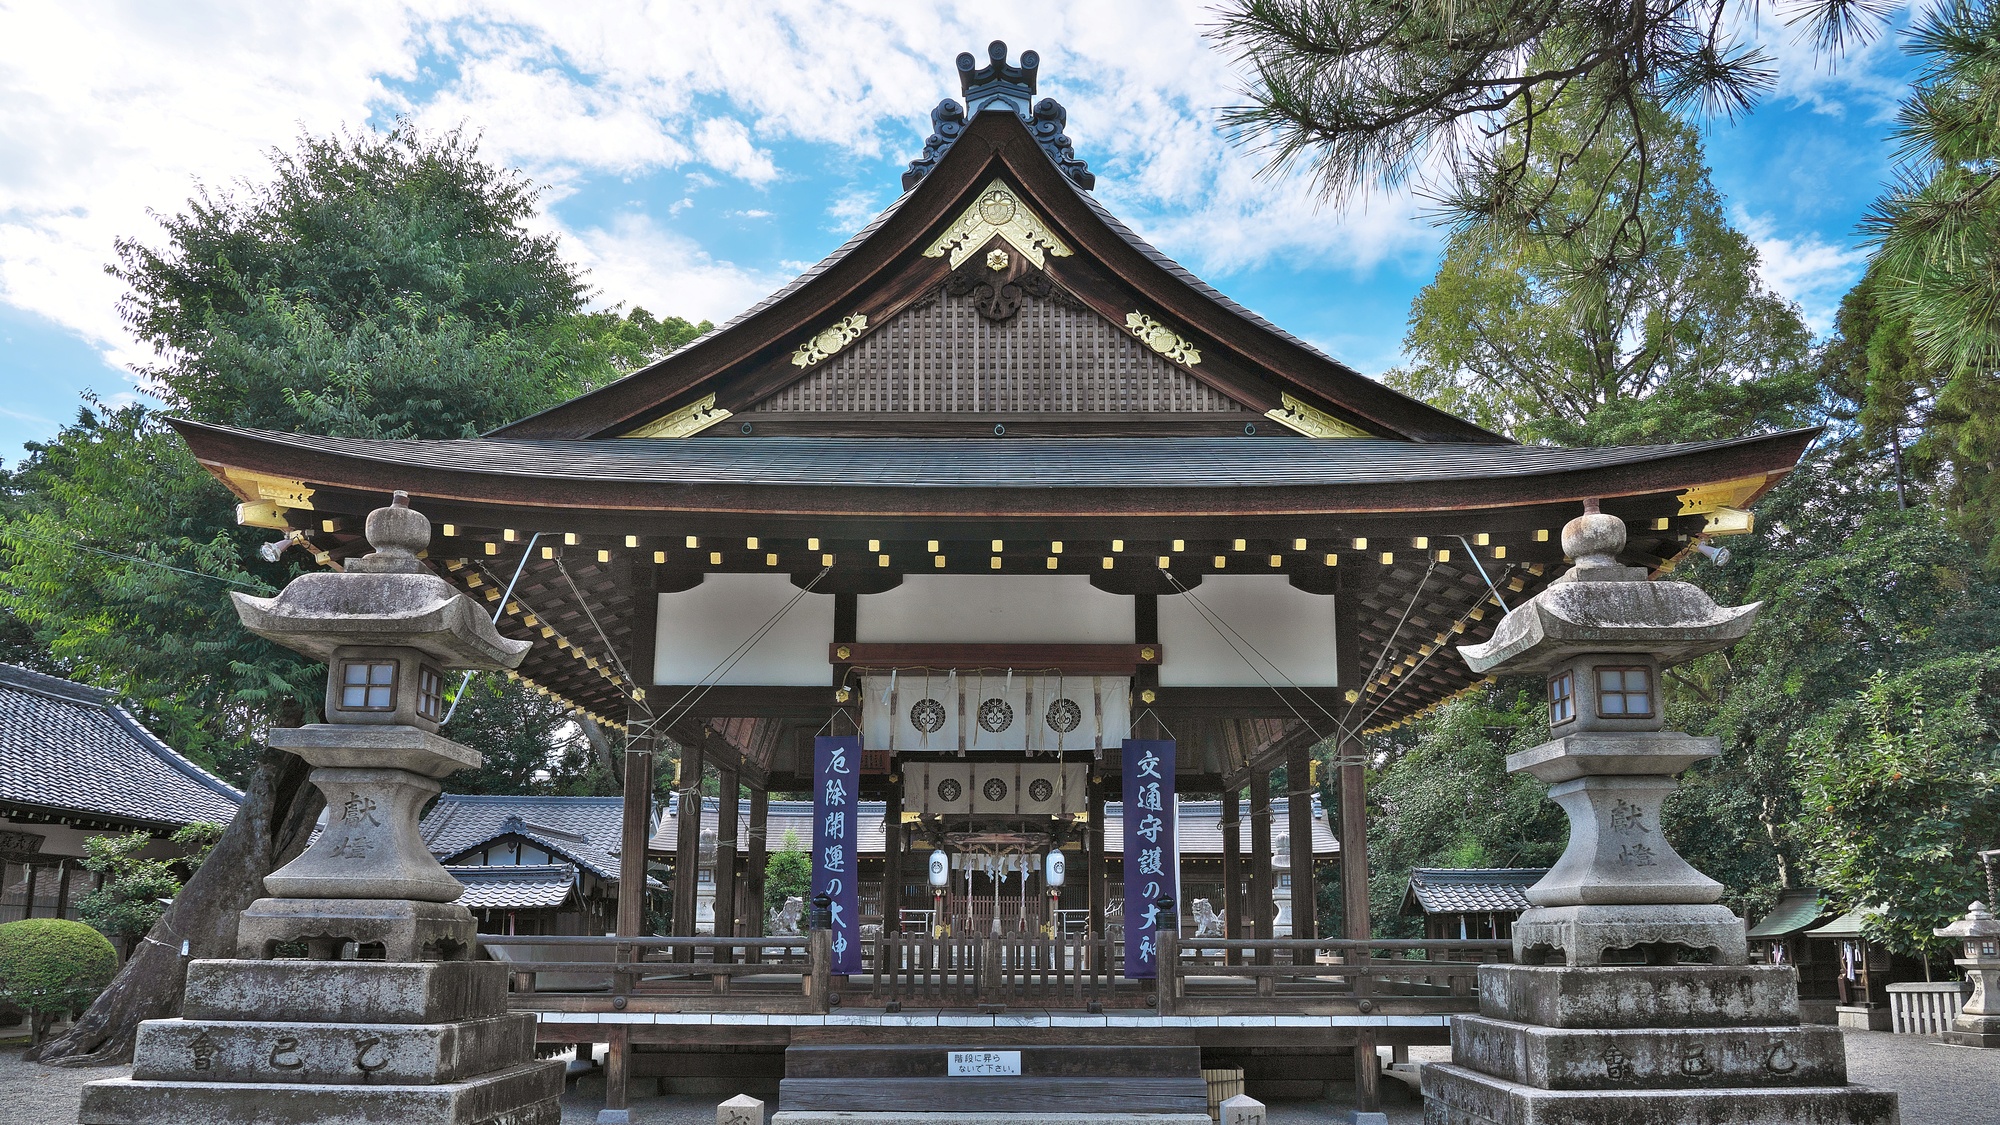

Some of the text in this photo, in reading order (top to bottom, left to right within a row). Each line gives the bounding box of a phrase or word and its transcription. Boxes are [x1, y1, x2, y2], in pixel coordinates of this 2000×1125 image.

[954, 1053, 1001, 1063] 階段に昇ら
[958, 1064, 1015, 1073] ないで下さい。
